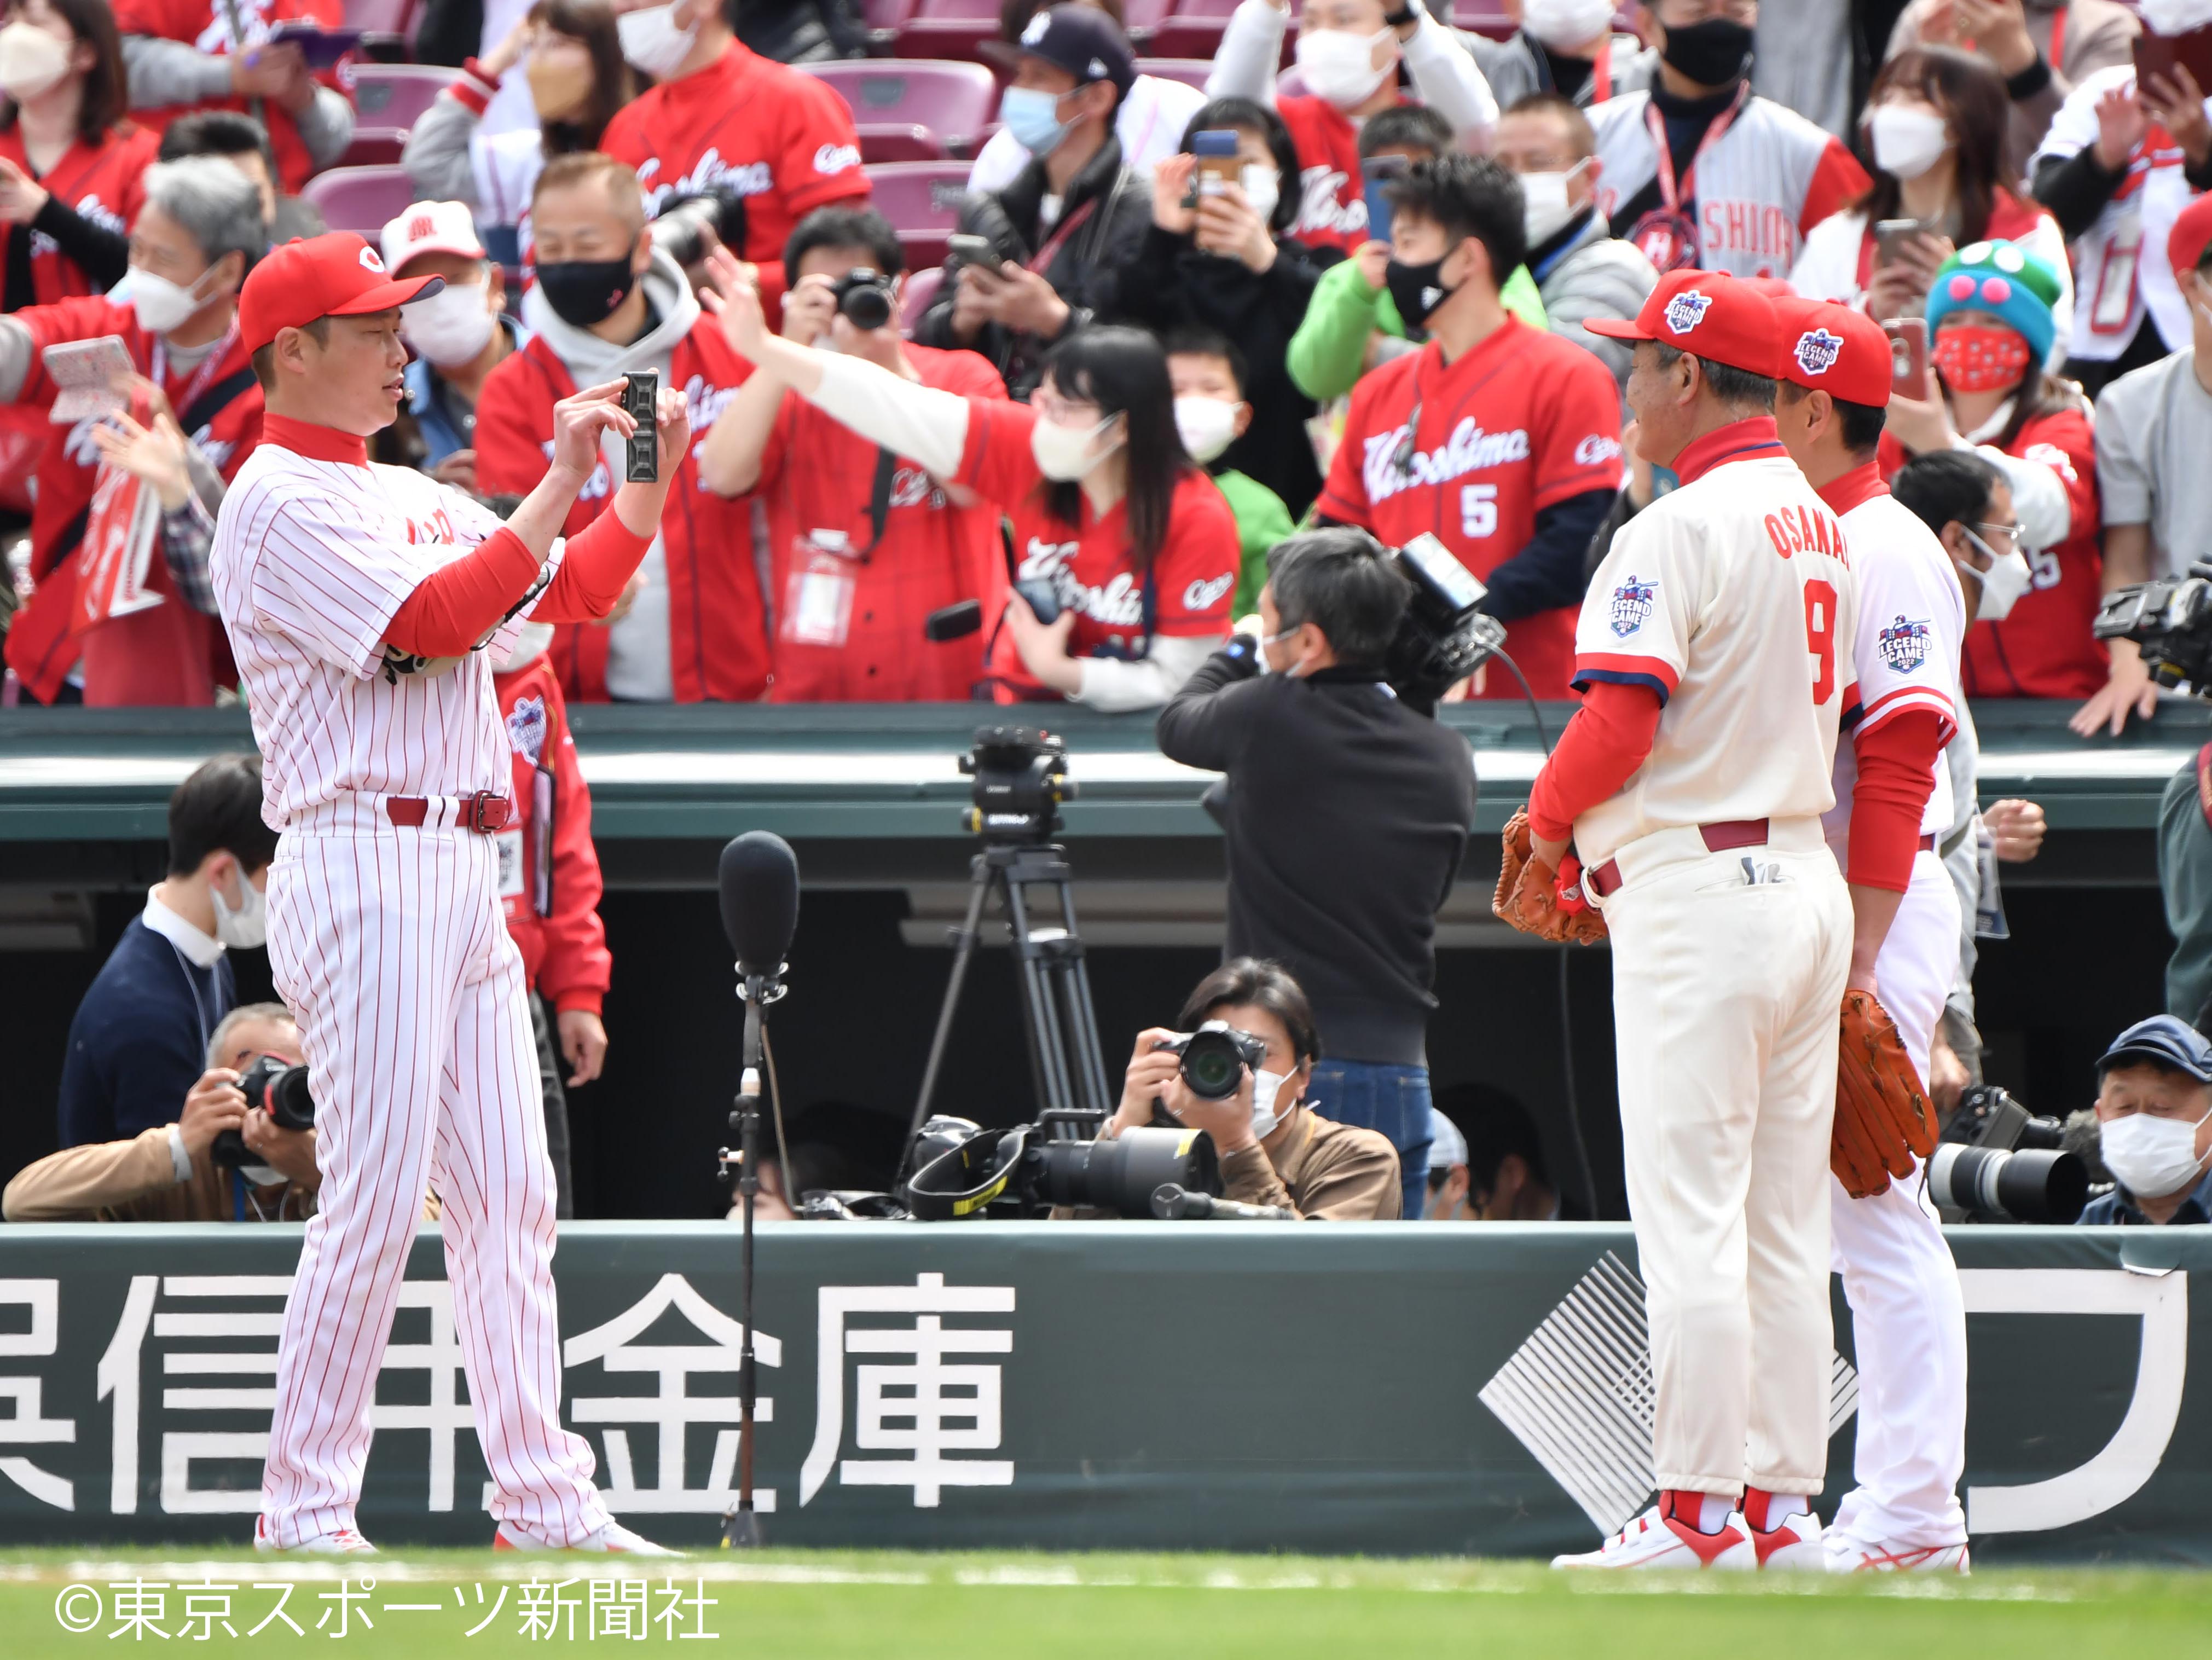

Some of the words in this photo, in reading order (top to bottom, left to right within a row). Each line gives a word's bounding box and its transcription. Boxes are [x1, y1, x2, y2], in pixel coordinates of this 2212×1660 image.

[359, 246, 385, 273] C
[1461, 484, 1498, 537] 5
[1804, 578, 1837, 705] 9
[1879, 636, 1932, 657] LEGEND
[1887, 647, 1924, 663] GAME
[1897, 658, 1915, 666] 2022
